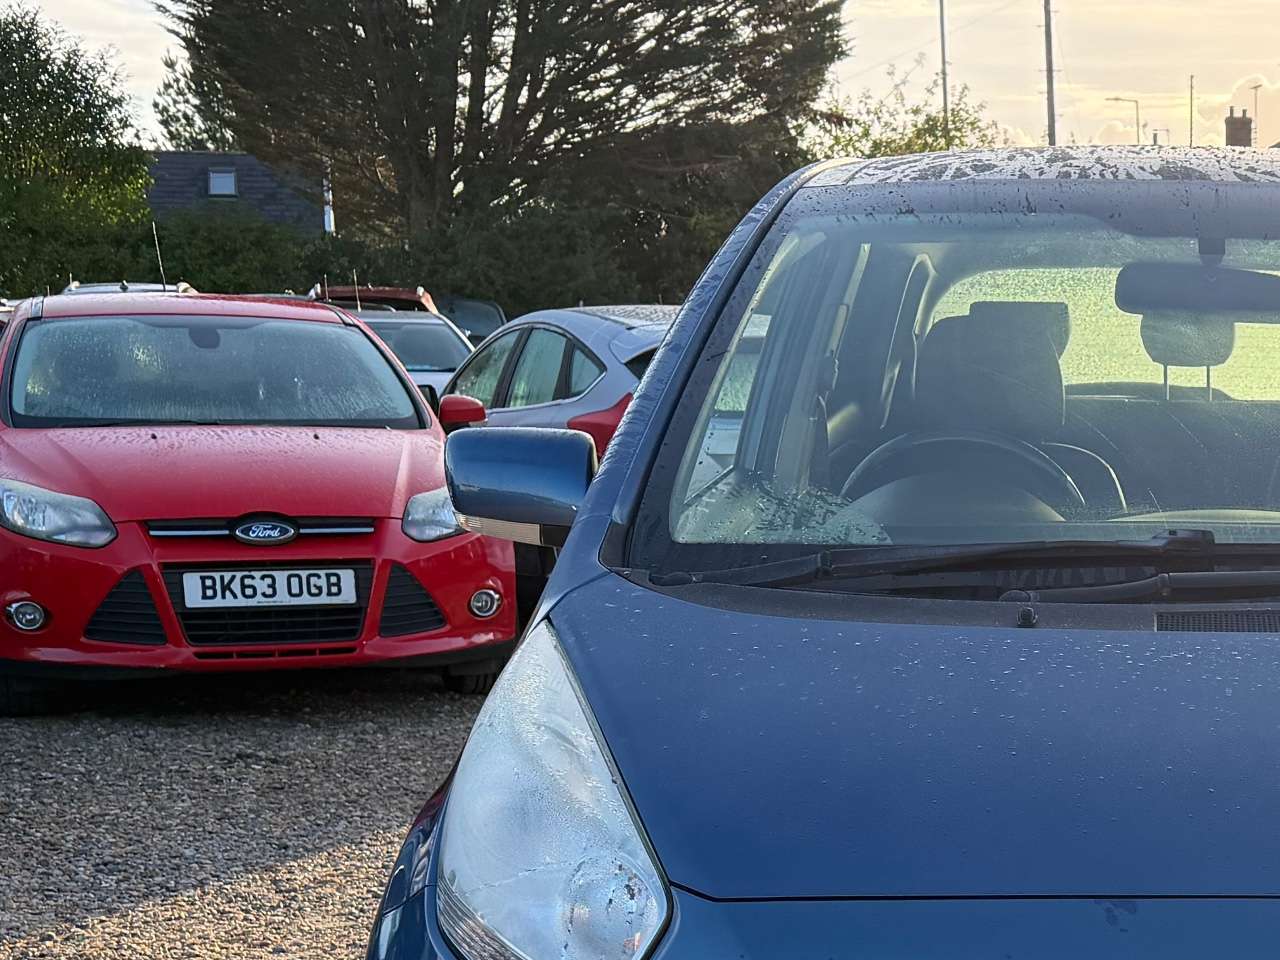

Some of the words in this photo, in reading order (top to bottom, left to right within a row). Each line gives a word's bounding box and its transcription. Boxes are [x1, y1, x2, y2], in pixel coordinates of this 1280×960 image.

[249, 524, 281, 537] Ford
[200, 573, 278, 600] BK63
[286, 572, 343, 598] OGB
